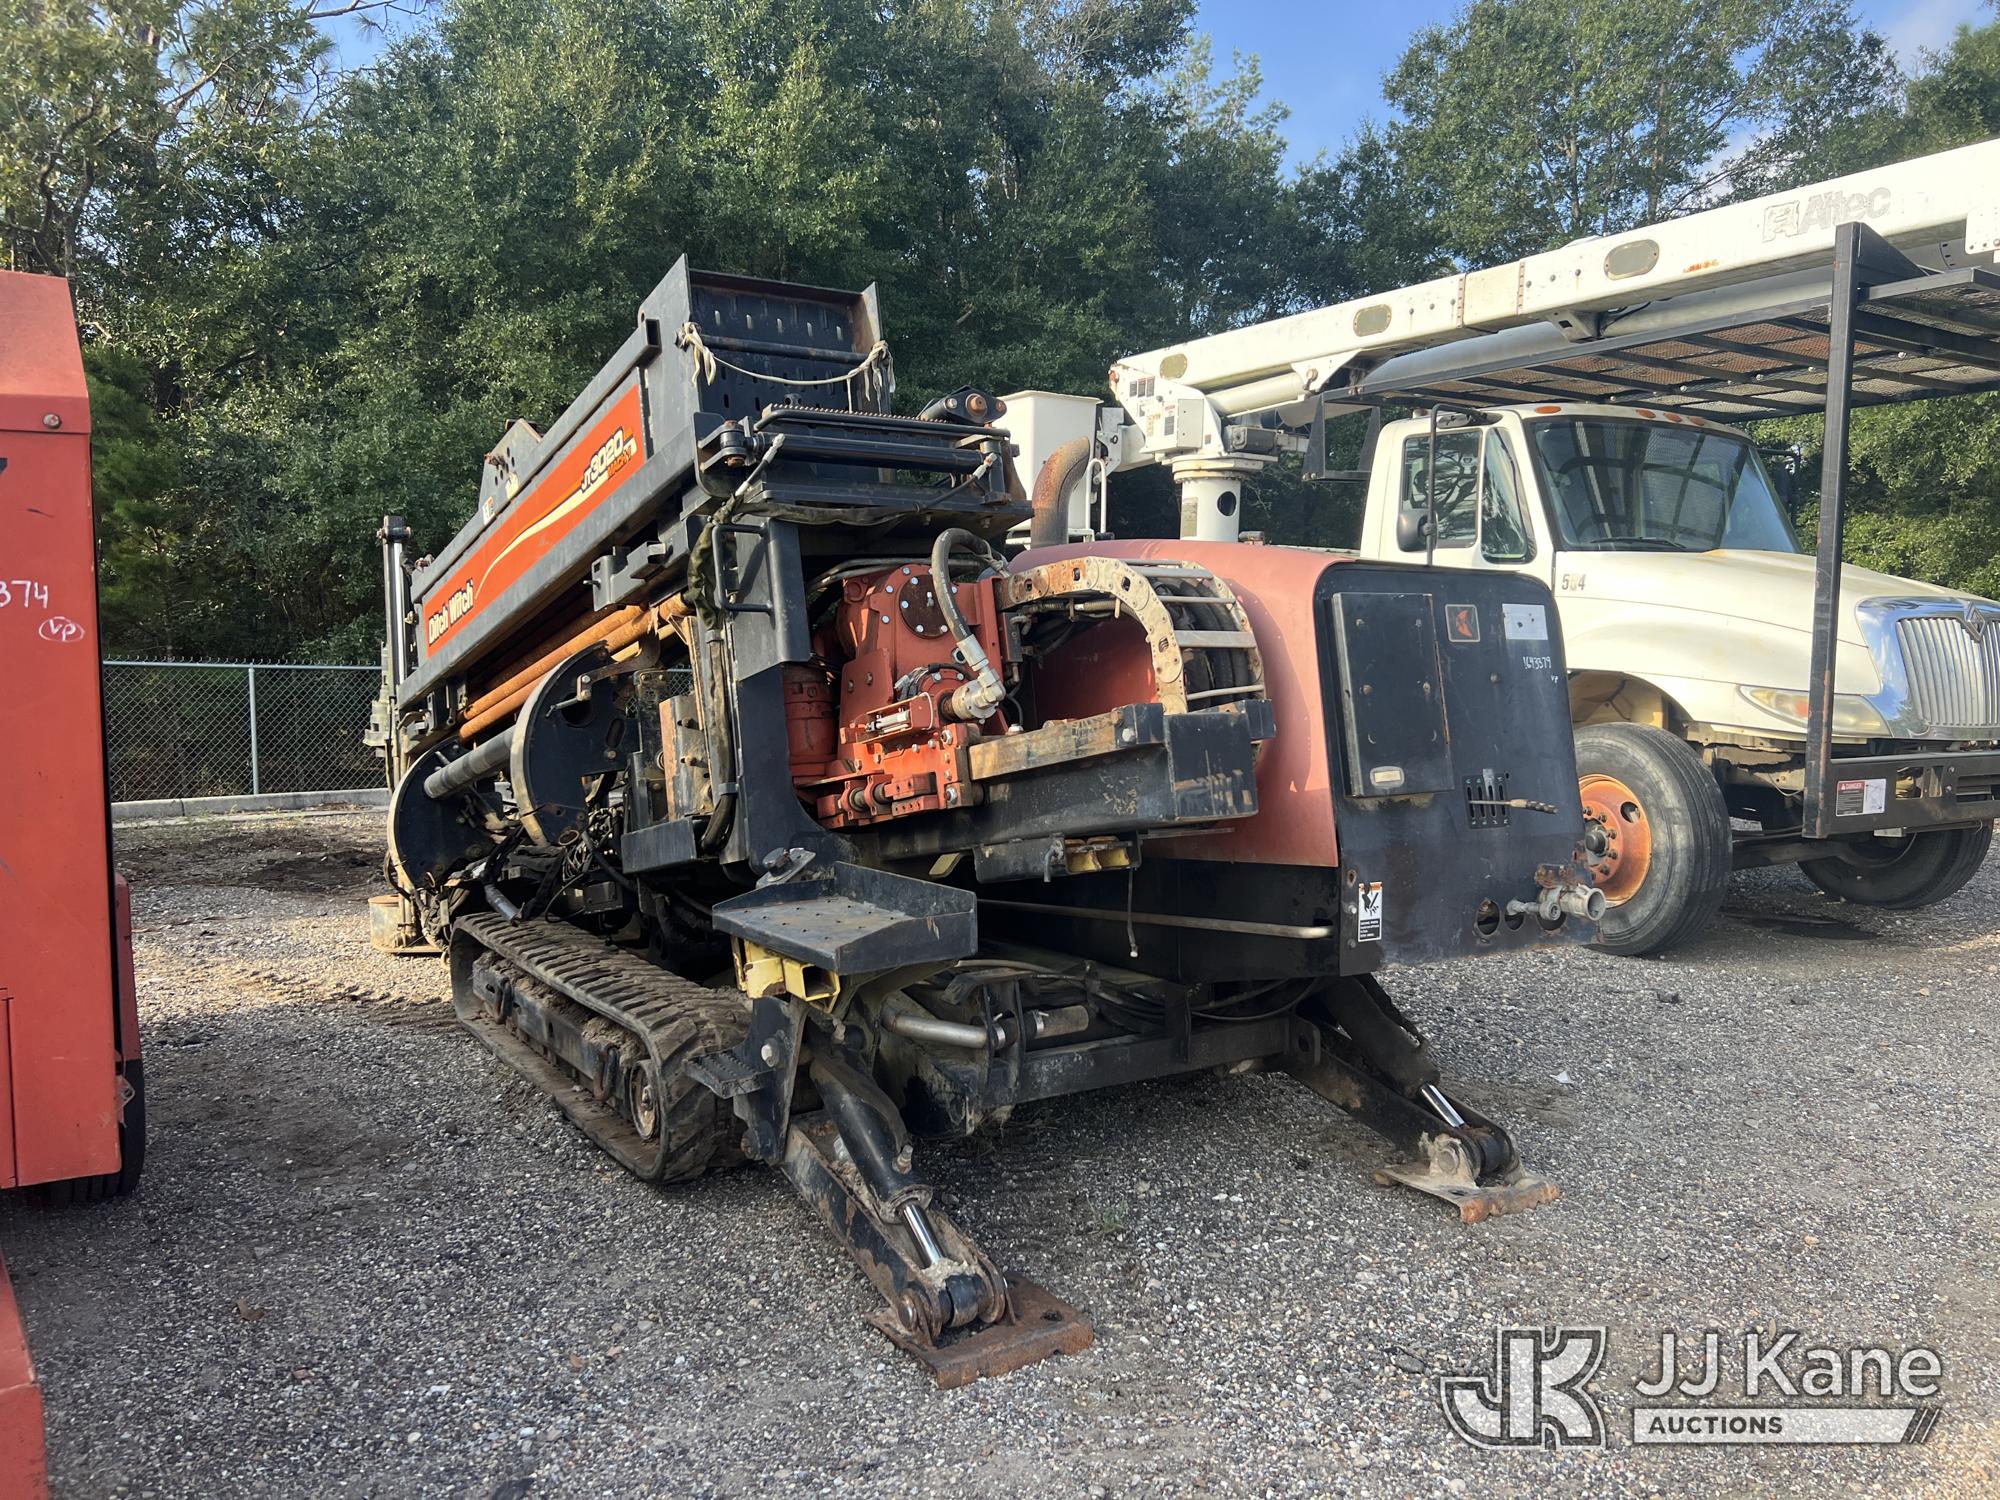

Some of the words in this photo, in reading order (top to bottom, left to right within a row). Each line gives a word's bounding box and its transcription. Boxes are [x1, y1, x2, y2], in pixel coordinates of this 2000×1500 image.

[581, 426, 624, 493] JT3020
[428, 603, 448, 646] Ditch
[449, 580, 473, 626] Witch
